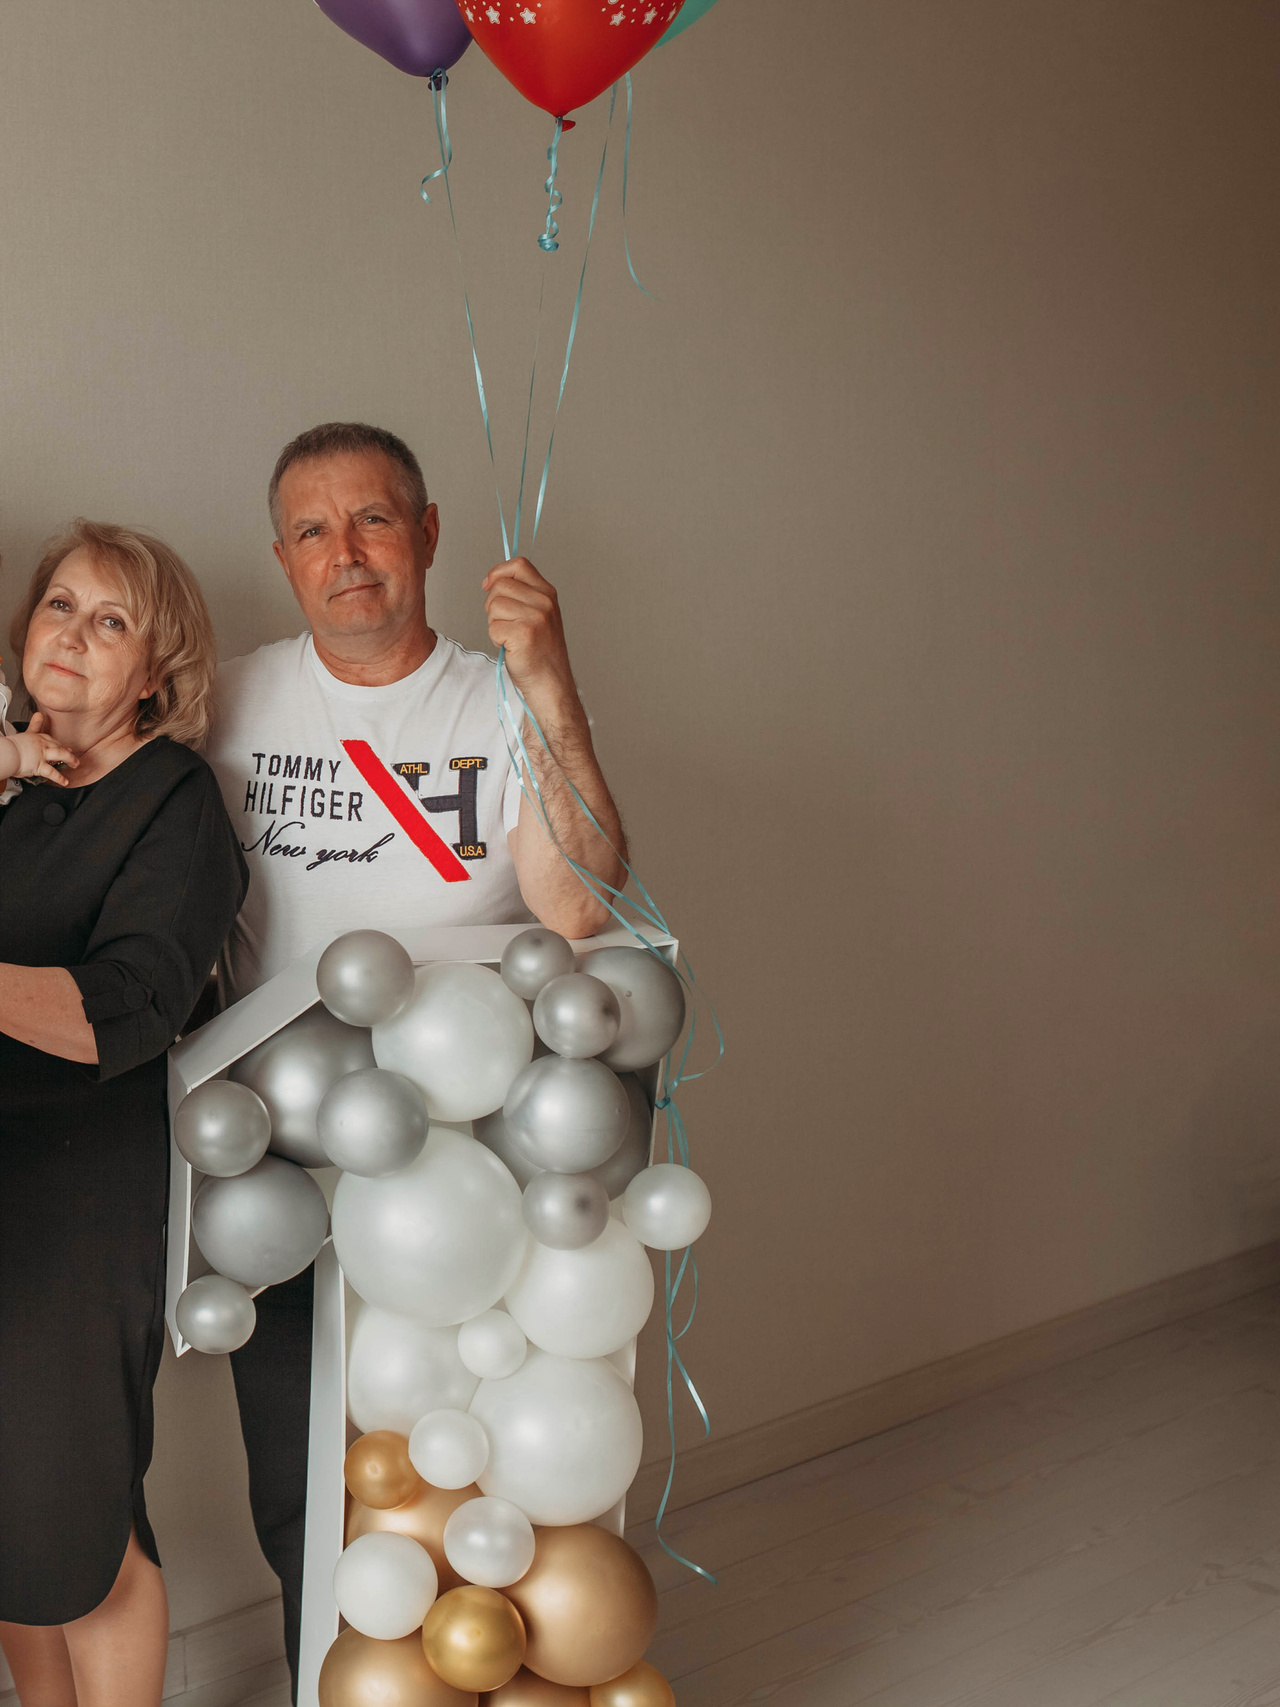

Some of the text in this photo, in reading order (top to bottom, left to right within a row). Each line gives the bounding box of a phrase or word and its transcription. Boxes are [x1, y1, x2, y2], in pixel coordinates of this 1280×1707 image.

[251, 752, 342, 783] TOMMY
[452, 758, 484, 769] DEPT.
[244, 780, 363, 822] HILFIGER
[241, 820, 307, 858] New
[459, 845, 485, 857] U.S.A.
